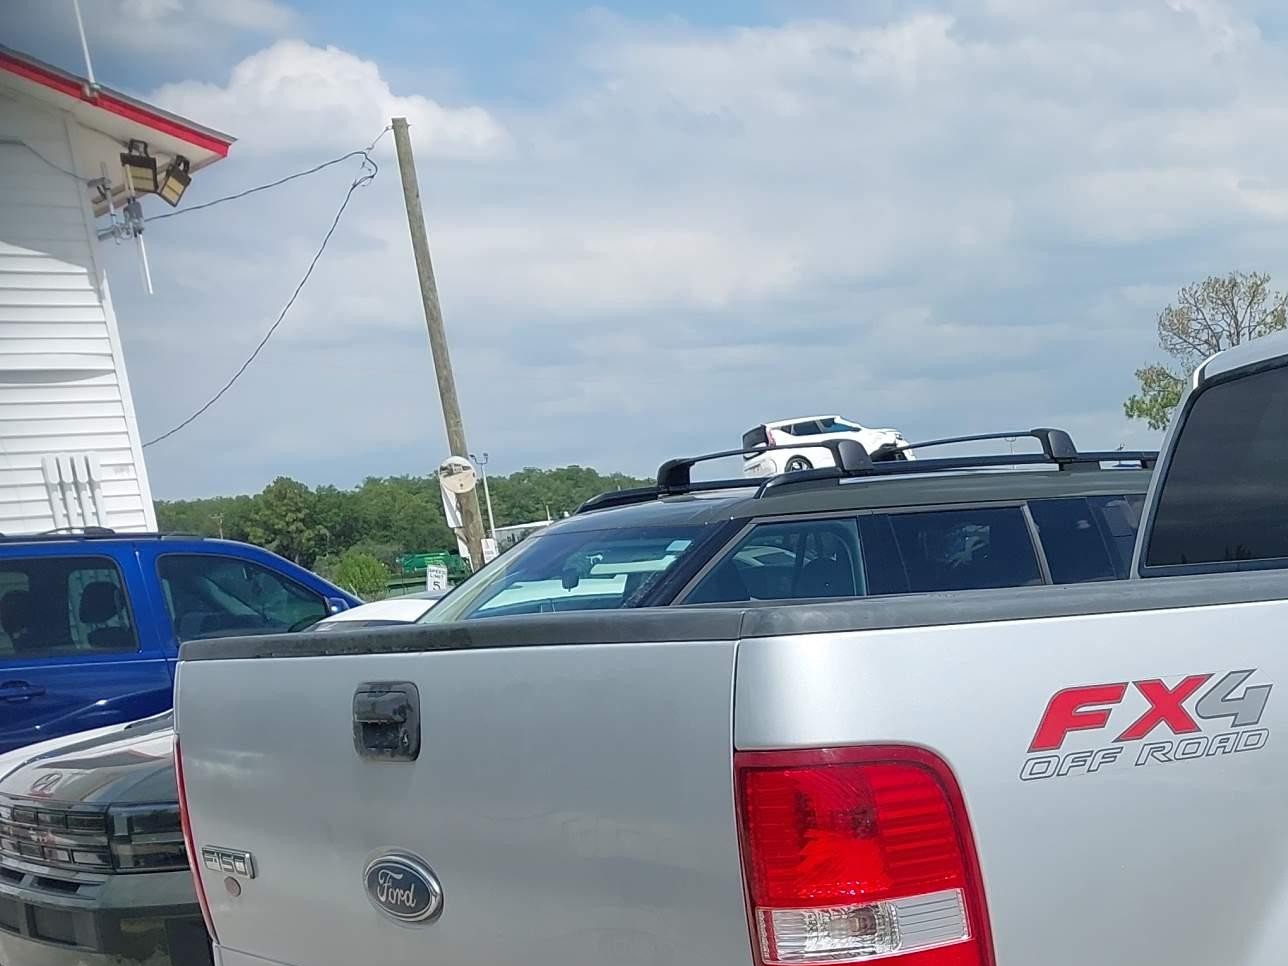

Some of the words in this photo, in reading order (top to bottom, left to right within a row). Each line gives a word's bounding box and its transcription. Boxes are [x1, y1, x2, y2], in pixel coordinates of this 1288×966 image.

[1027, 668, 1273, 753] FX4
[1019, 746, 1124, 782] OFF
[1134, 728, 1270, 767] ROAD
[377, 869, 417, 907] Ford
